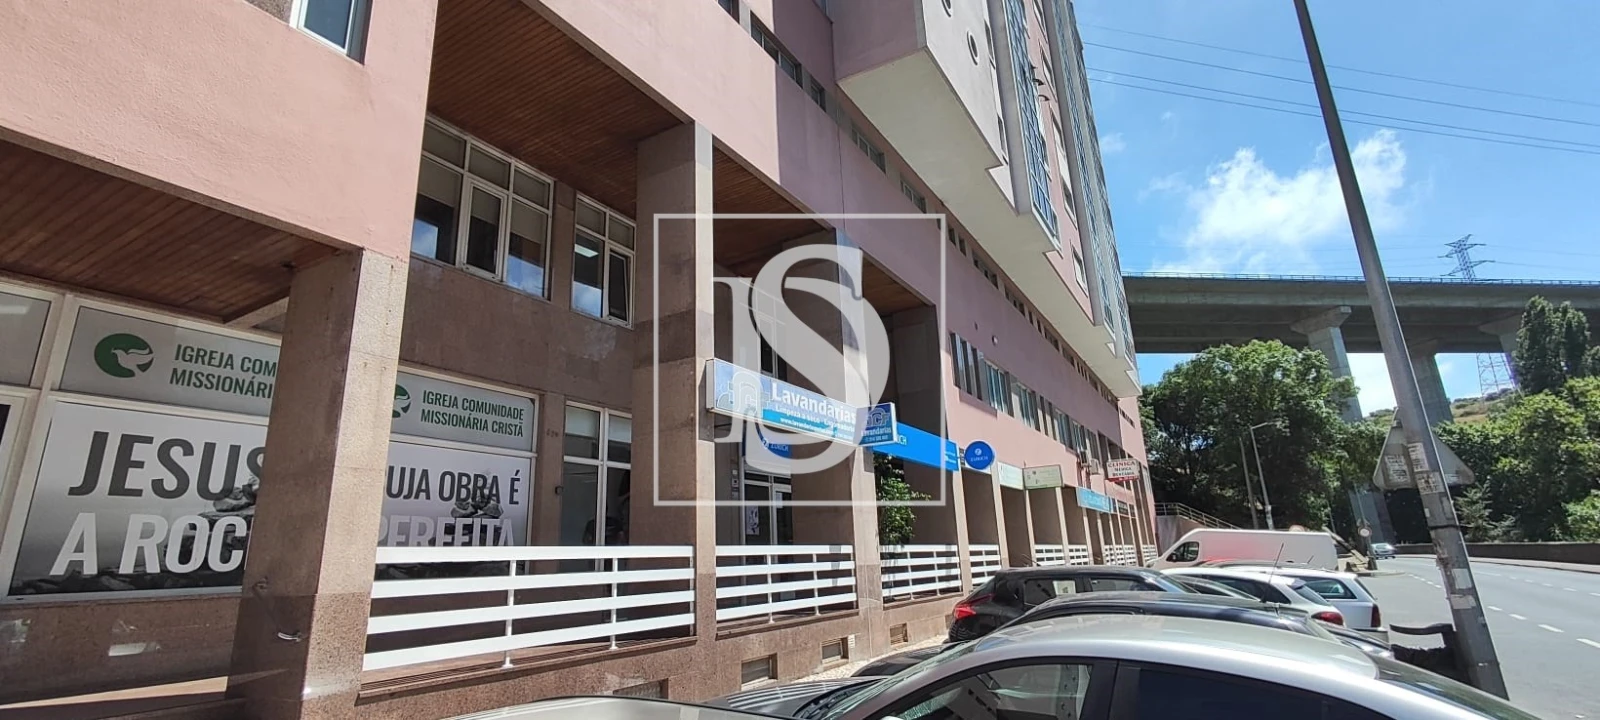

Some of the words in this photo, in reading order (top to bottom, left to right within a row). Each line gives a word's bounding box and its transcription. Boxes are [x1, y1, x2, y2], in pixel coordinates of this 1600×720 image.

[174, 343, 234, 371] IGREJA
[422, 389, 459, 409] IGREJA
[461, 397, 525, 421] COMUNIDADE
[772, 381, 857, 424] Lavandarias
[420, 408, 489, 433] MISSIONÁRIA
[491, 420, 524, 438] CRISTÃ
[385, 465, 431, 500] UJA
[438, 470, 501, 505] OBRA
[508, 469, 521, 505] É
[50, 512, 98, 576] A
[119, 513, 253, 574] ROC
